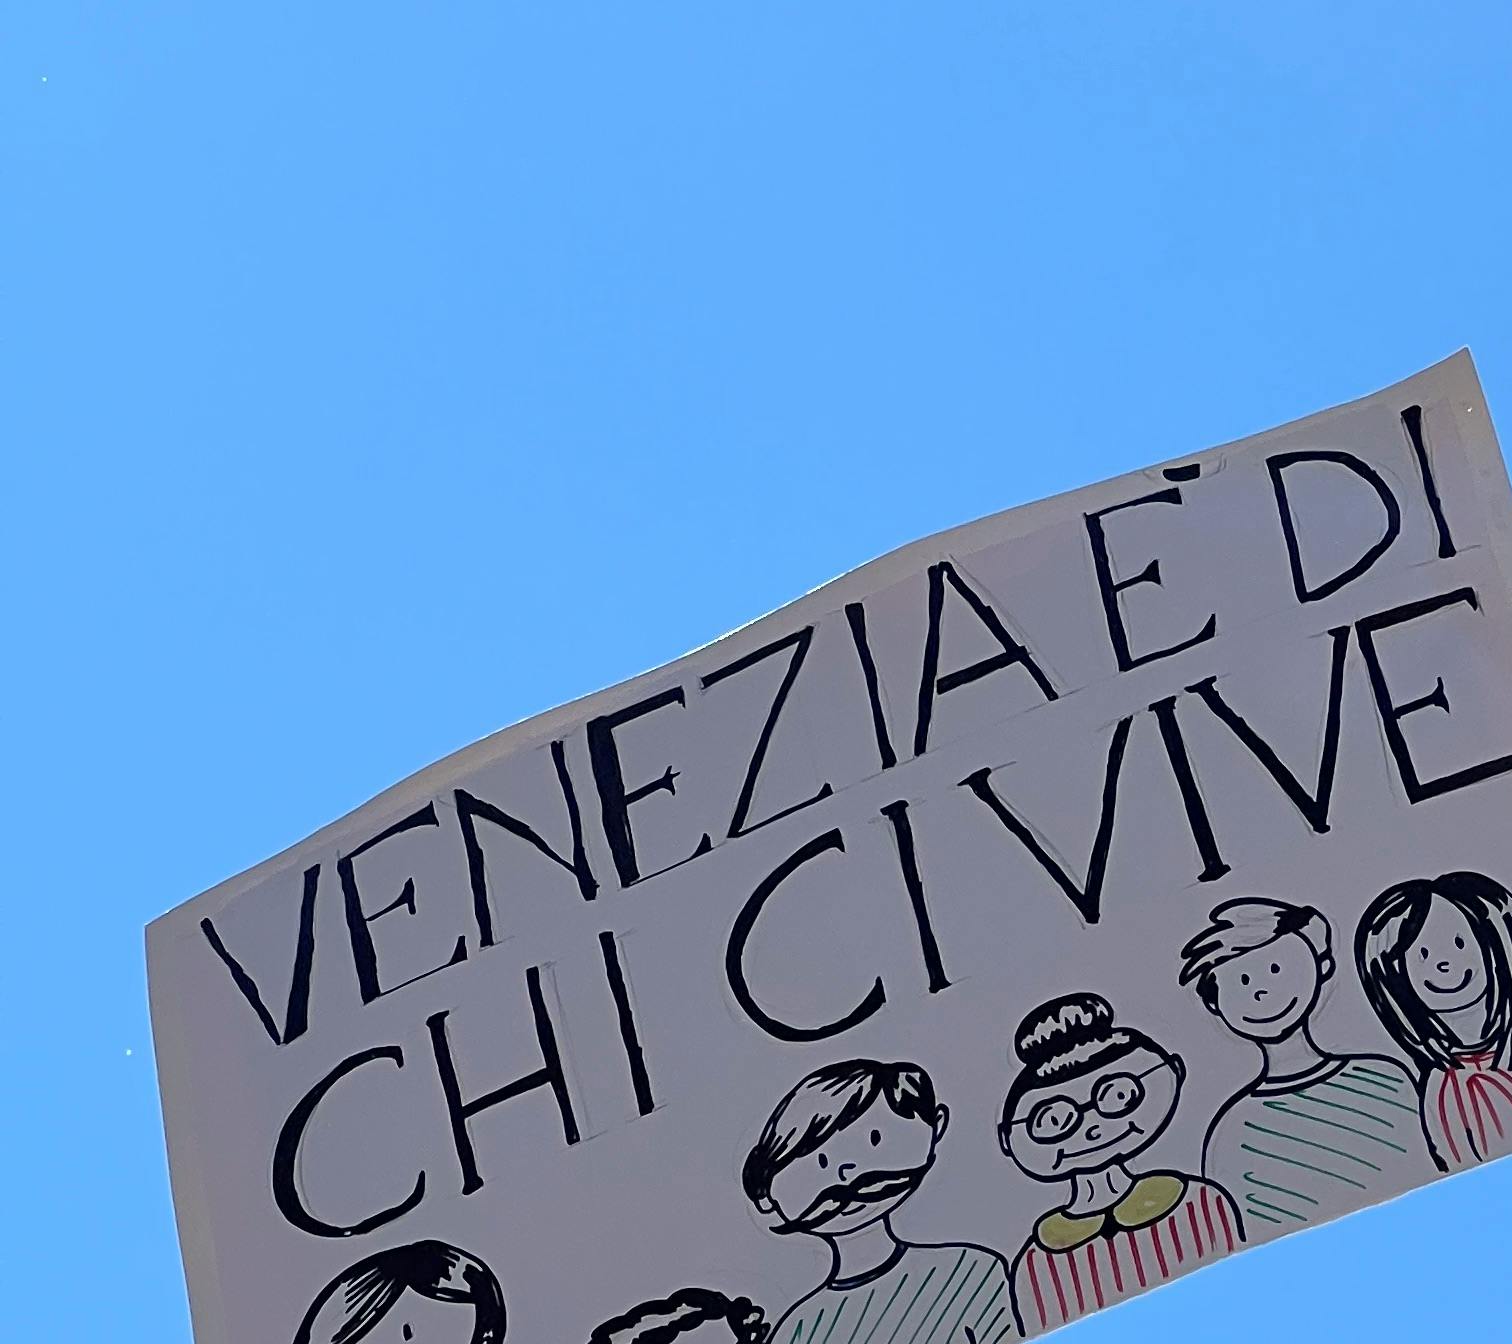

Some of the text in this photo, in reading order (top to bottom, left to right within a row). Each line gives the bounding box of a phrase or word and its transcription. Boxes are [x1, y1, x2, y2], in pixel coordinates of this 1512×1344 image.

[199, 560, 1060, 1046] VENEZIA
[1265, 404, 1457, 604] DI
[272, 930, 655, 1238] CHI
[725, 799, 953, 1043] CI
